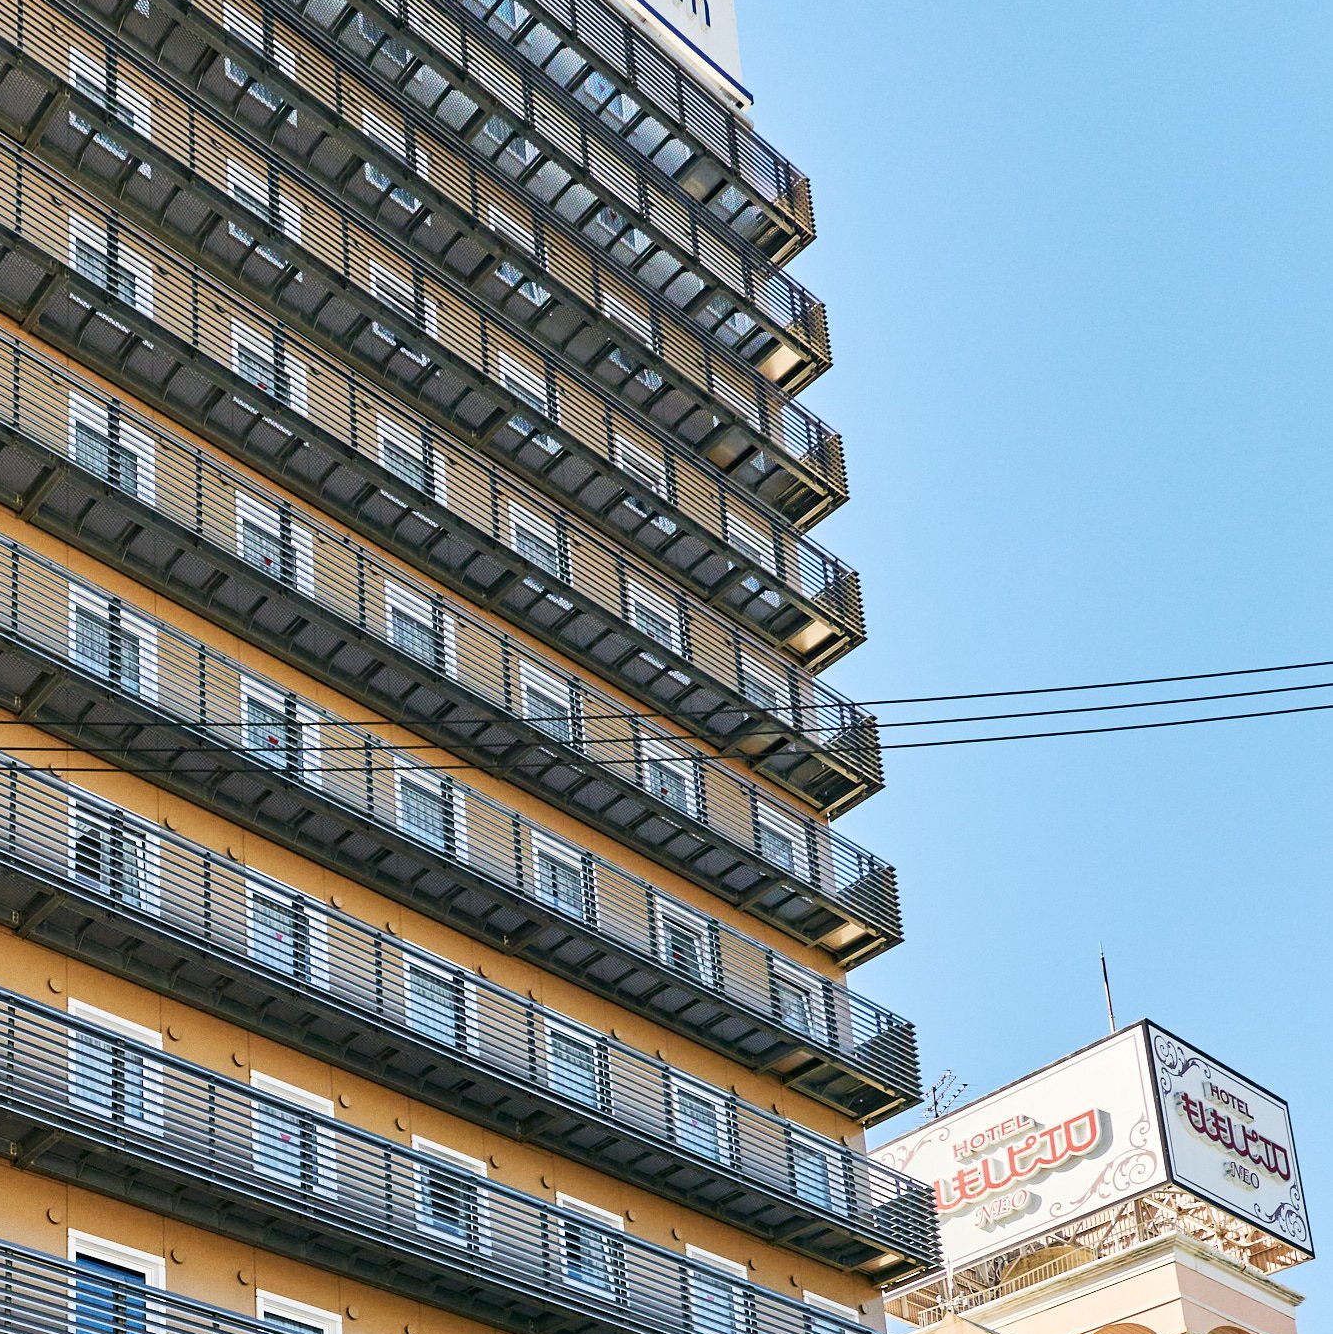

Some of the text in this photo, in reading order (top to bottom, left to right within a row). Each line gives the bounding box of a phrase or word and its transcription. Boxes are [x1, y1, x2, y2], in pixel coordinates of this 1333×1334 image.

[1209, 1082, 1254, 1120] HOTEL
[953, 1115, 1031, 1159] HOTEL
[1181, 1092, 1291, 1181] もしもしピエロ
[933, 1109, 1098, 1211] しもしピエロ
[1230, 1161, 1260, 1189] NEO
[975, 1189, 1028, 1227] NEO
